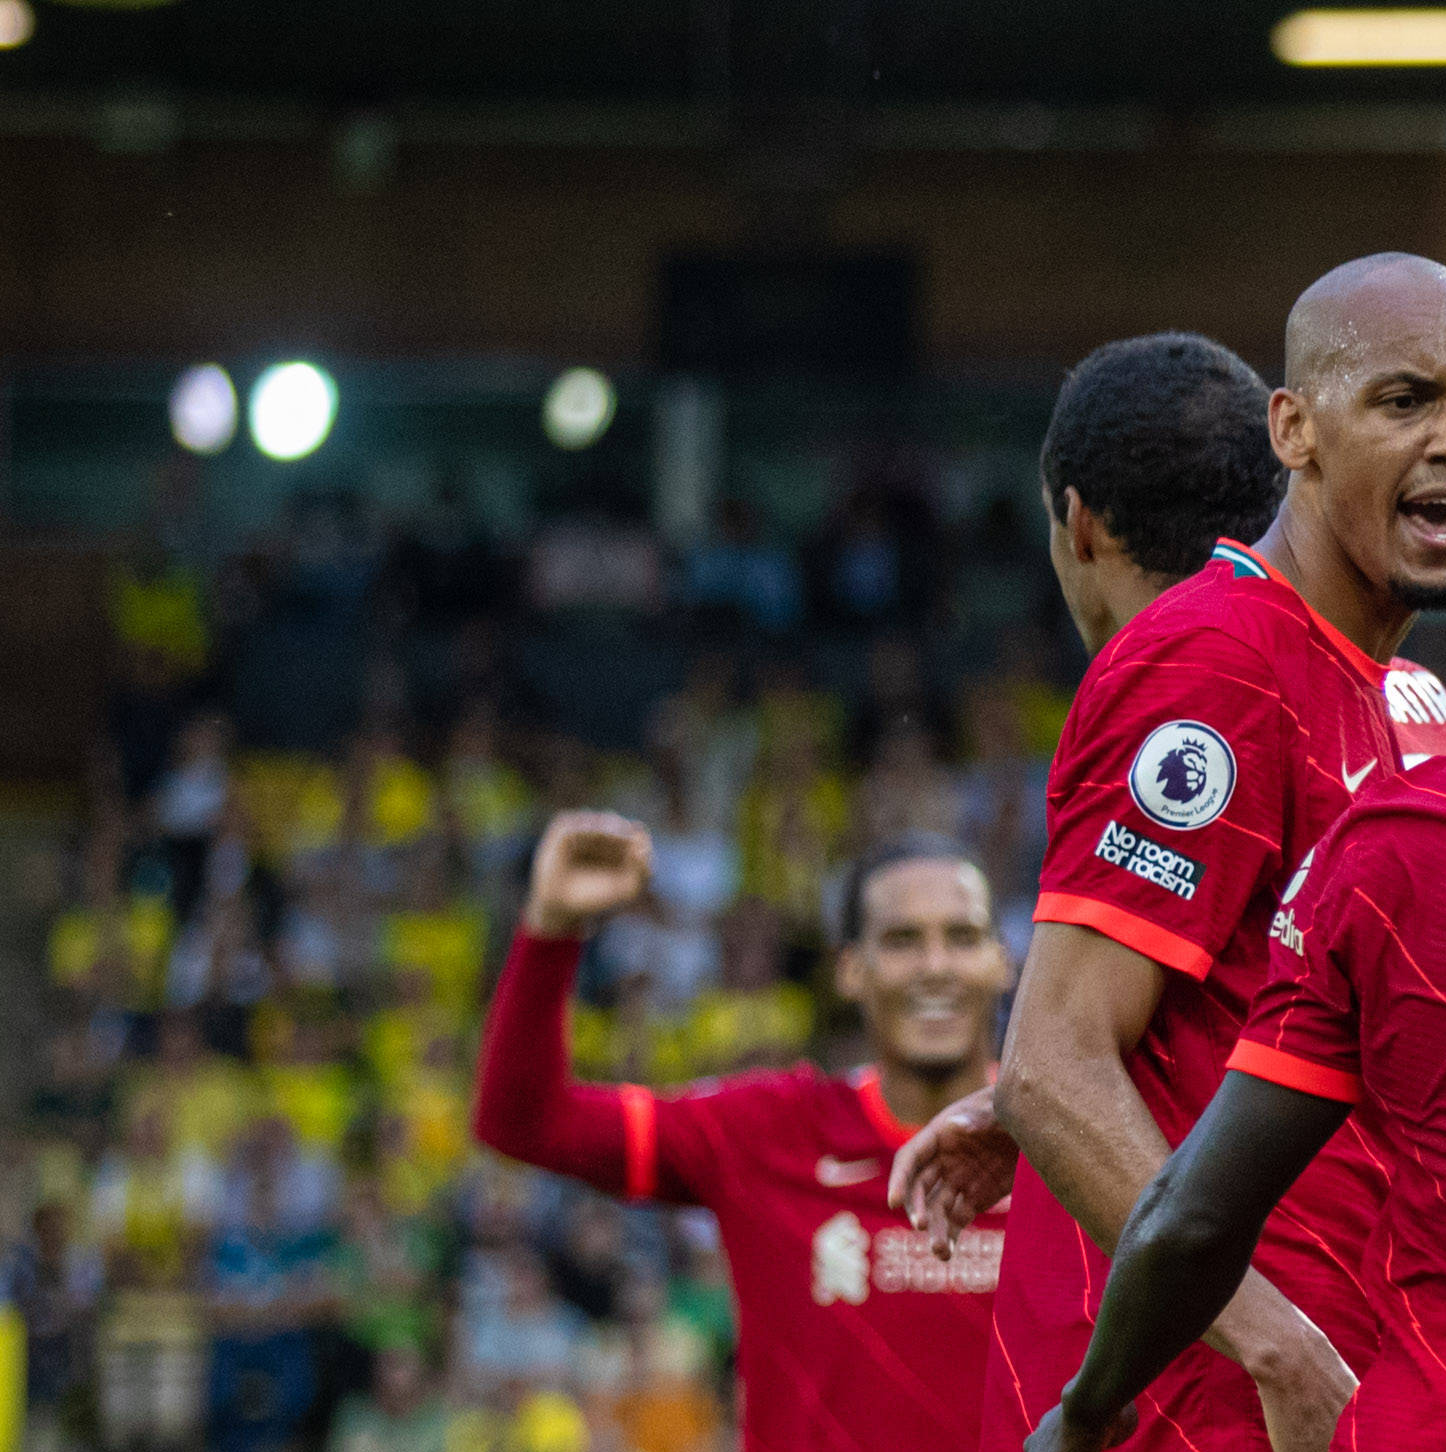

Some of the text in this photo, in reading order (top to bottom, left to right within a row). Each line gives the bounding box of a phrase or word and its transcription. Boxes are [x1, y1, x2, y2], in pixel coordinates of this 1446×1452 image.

[1160, 787, 1219, 818] Premier League
[1101, 819, 1195, 879] No room
[1126, 853, 1197, 901] racism
